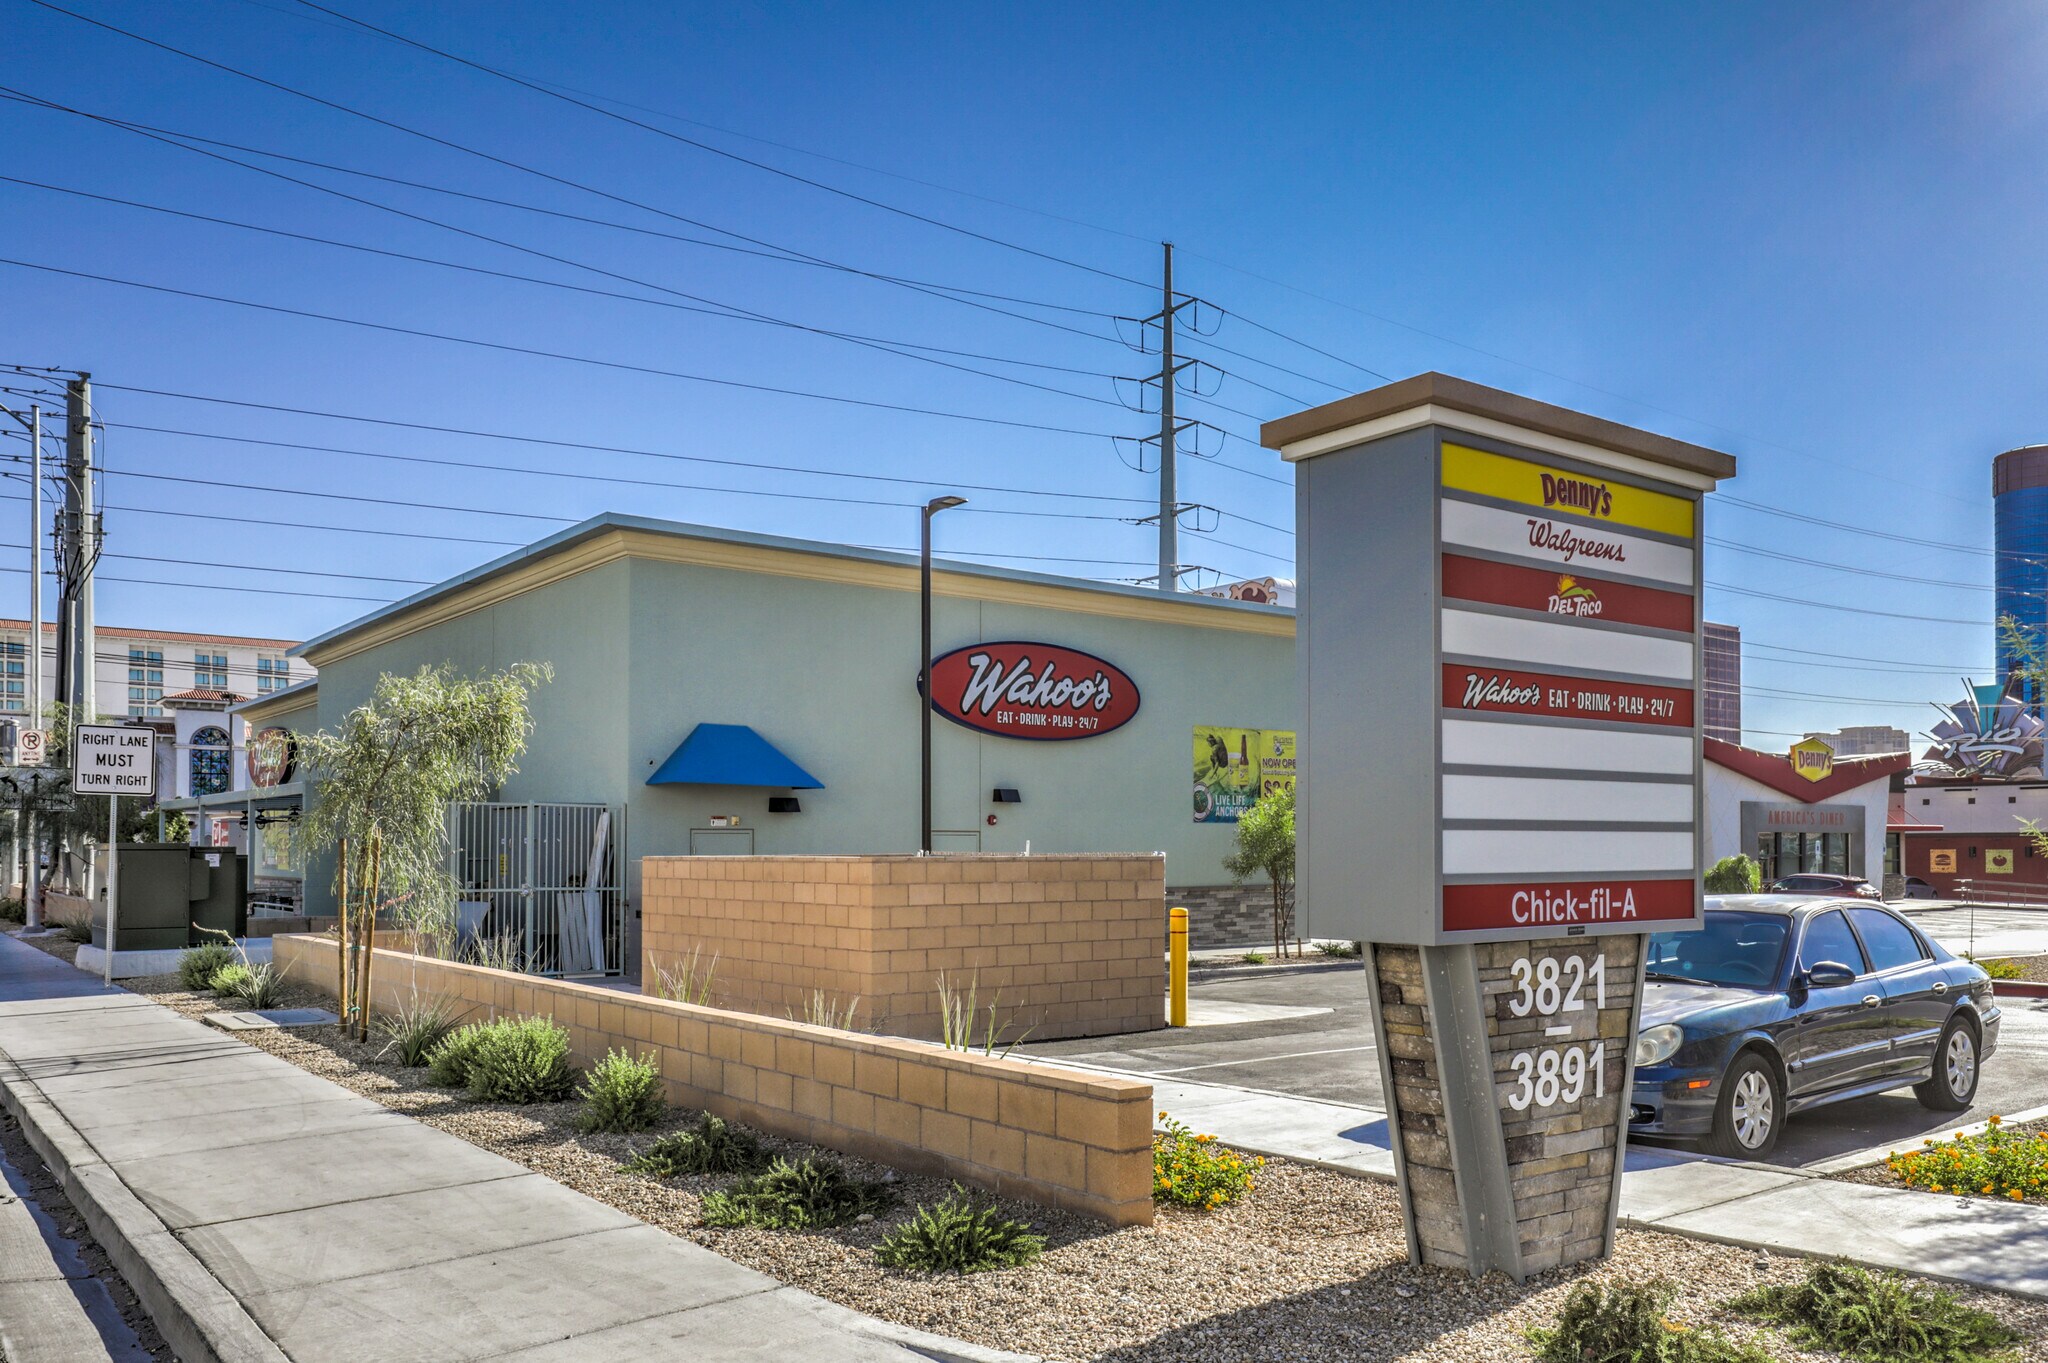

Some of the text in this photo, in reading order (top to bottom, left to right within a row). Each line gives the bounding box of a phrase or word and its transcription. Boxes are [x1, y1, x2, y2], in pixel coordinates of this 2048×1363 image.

[1540, 473, 1612, 517] Denny's
[1527, 519, 1626, 562] Walgreens
[1548, 595, 1602, 617] DEL TACO
[961, 652, 1113, 716] Wahoo's
[1462, 672, 1541, 709] Wahoo's
[1549, 688, 1675, 717] EAT DRINK PLAY 24/7
[997, 710, 1099, 730] EAT DRINK PLAY 24/7
[82, 733, 148, 747] RIGHT LANE
[1937, 724, 2025, 759] Rio
[96, 753, 134, 767] MUST
[1262, 757, 1296, 769] NOW OPE
[1798, 750, 1832, 771] Denny's
[81, 773, 148, 786] TURN RIGHT
[1215, 795, 1246, 806] LIVE LIFE
[1768, 810, 1845, 825] AMERICA'S DINER
[1511, 888, 1637, 923] Chick-fil-A
[1509, 954, 1606, 1017] 3821
[1508, 1042, 1605, 1111] 3891
